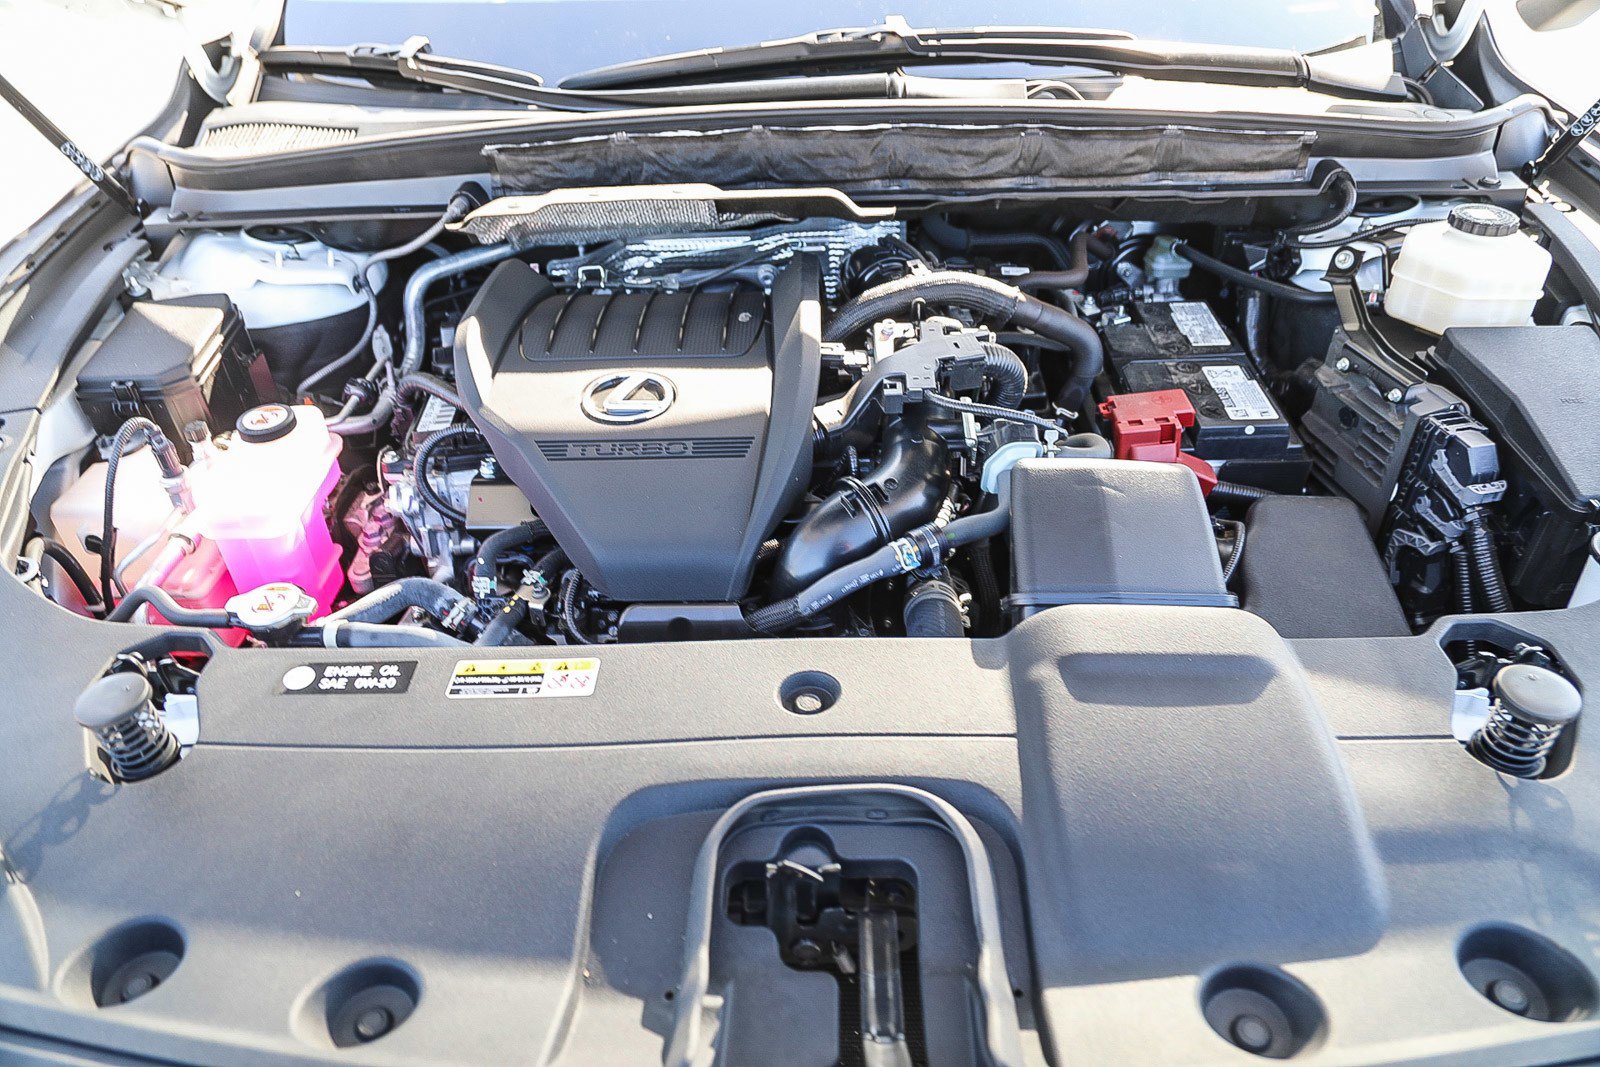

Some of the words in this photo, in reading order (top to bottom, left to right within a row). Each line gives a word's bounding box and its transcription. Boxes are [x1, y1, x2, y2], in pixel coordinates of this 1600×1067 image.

[571, 441, 688, 456] TURBO
[323, 665, 374, 678] ENGINE
[379, 665, 401, 677] OIL
[318, 677, 349, 690] SAE
